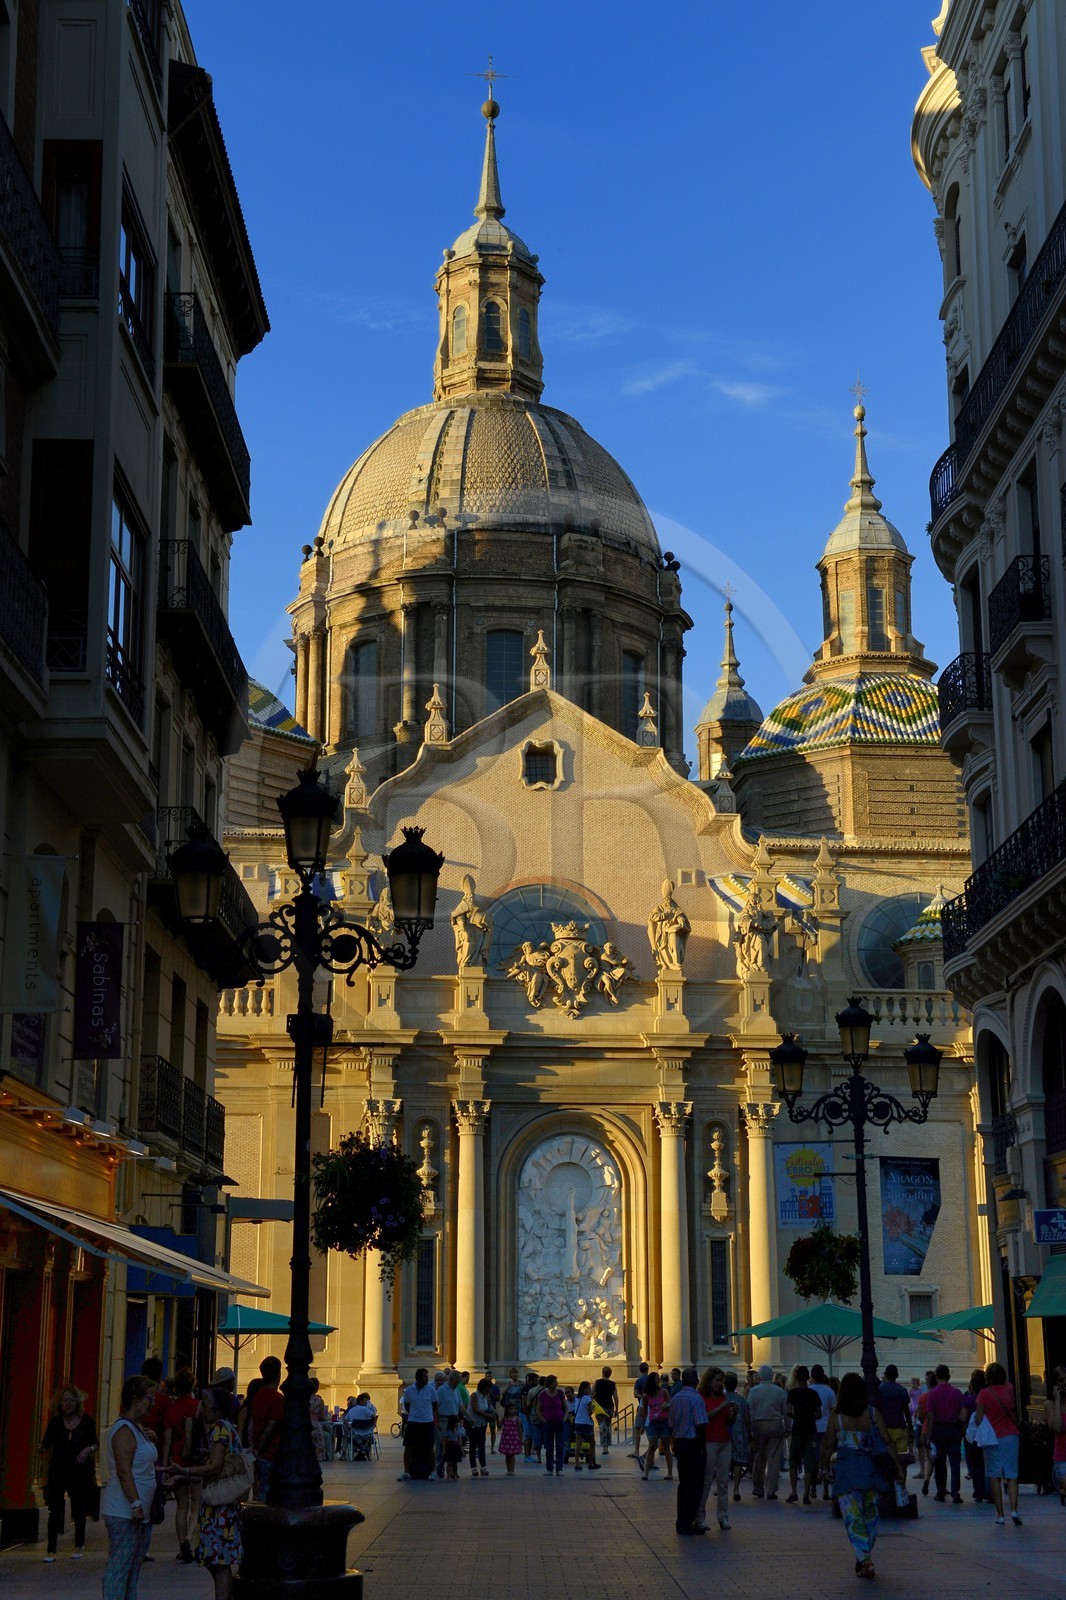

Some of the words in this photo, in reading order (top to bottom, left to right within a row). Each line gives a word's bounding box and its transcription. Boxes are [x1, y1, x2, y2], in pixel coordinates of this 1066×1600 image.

[25, 878, 42, 990] apartments
[92, 952, 111, 1028] Sabinas
[787, 1166, 812, 1174] EBRO
